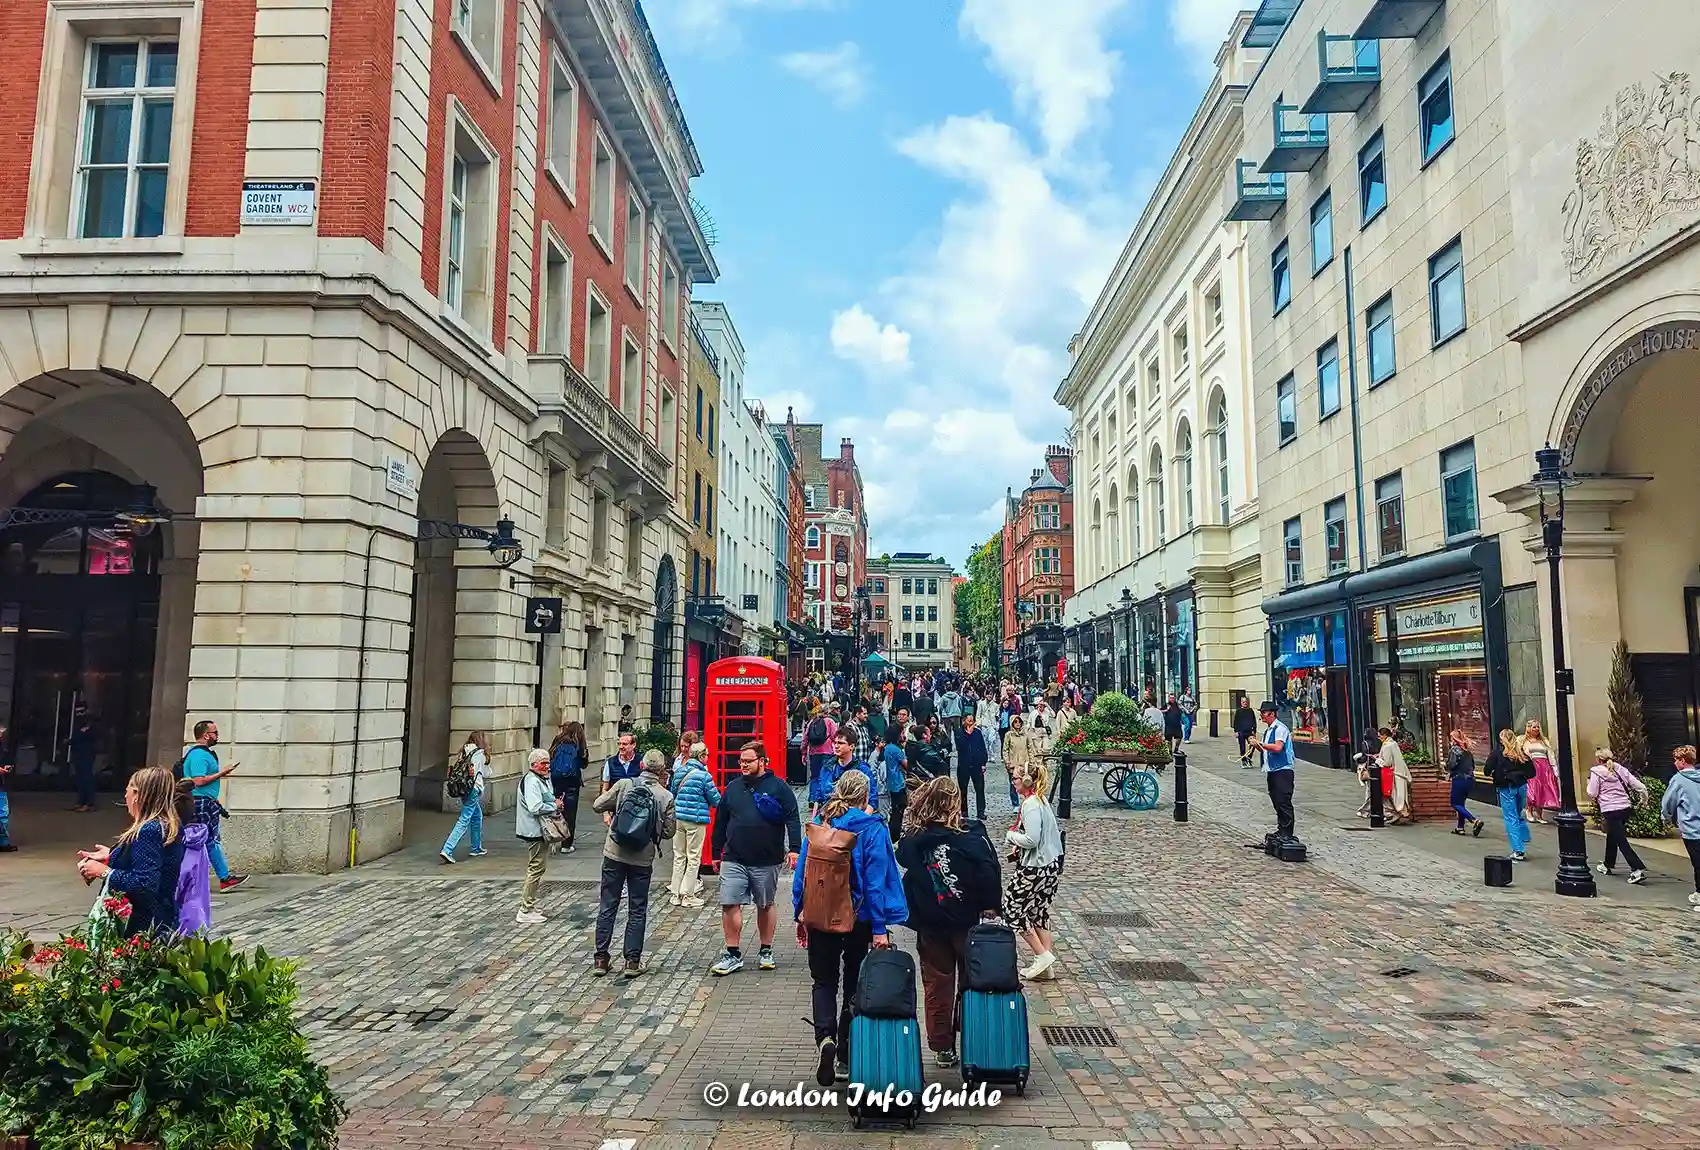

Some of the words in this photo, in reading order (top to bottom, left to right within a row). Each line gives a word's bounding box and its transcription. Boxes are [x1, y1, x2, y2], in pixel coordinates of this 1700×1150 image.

[247, 193, 282, 203] COVENT
[246, 204, 283, 213] GARDEN
[288, 204, 308, 214] WC2
[1560, 398, 1593, 468] ROYAL
[1591, 346, 1638, 397] OPERA
[1640, 329, 1697, 358] HOUSE
[1296, 633, 1318, 653] HOKA
[716, 677, 768, 685] TELEPHONE
